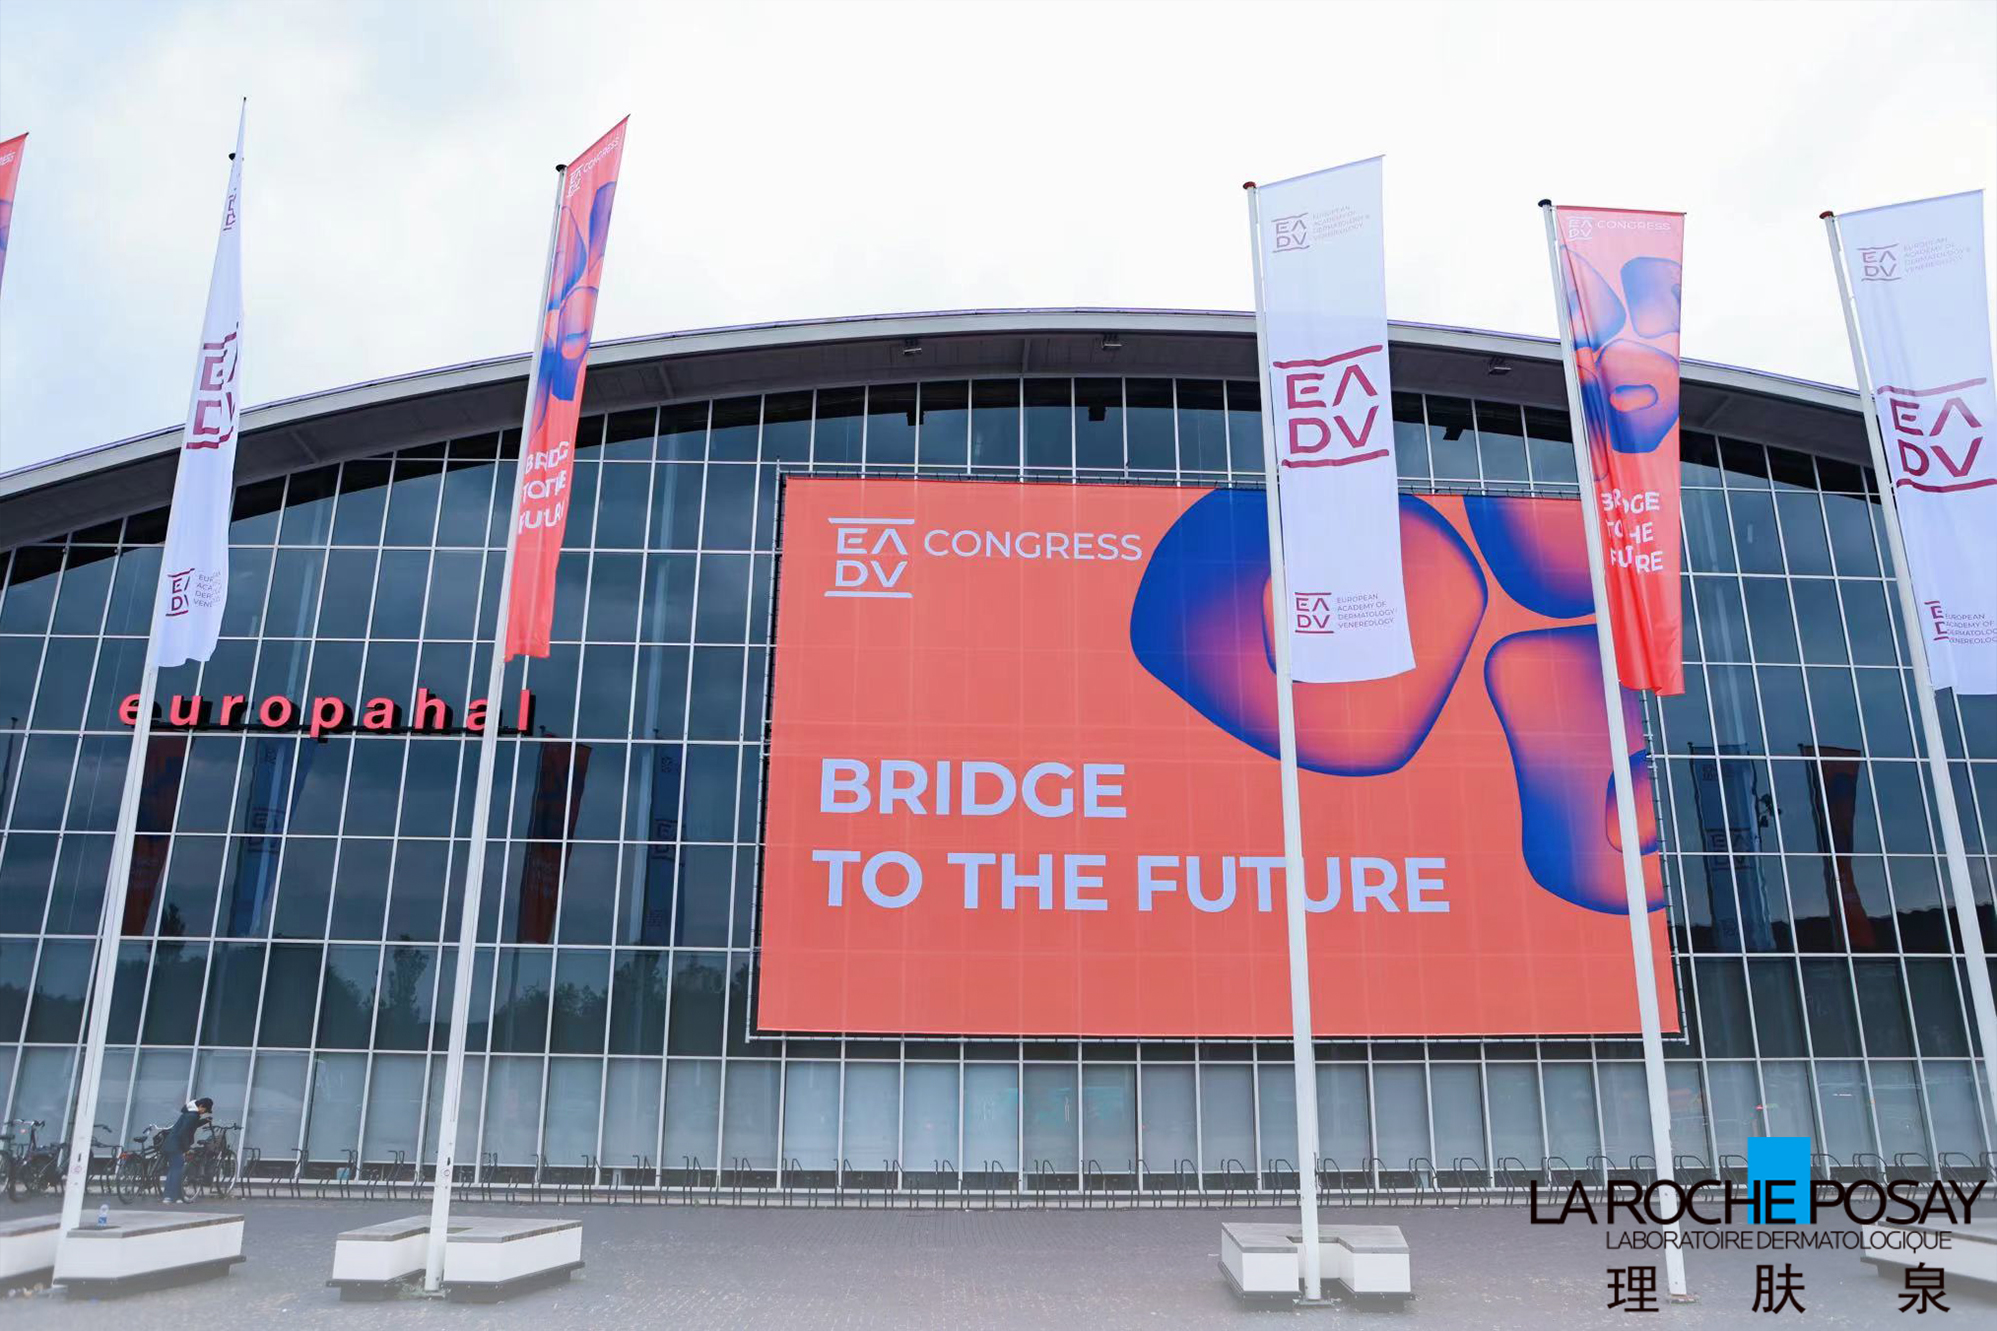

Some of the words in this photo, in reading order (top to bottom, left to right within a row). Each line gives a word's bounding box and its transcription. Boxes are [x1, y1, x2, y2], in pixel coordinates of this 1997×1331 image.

[1597, 220, 1671, 231] CONGRESS
[1288, 405, 1380, 454] DV
[1897, 436, 1984, 478] DV
[836, 527, 908, 555] EA
[923, 529, 1143, 561] CONGRESS
[835, 560, 908, 587] DV
[1337, 593, 1379, 604] EUROPEAN
[1337, 603, 1375, 612] ACADEMY
[1375, 600, 1387, 608] OF
[1297, 614, 1330, 629] DV
[1337, 607, 1395, 621] DERMATOLOGY
[1338, 617, 1395, 629] VENEREOLOGY
[118, 688, 530, 738] europahal
[819, 757, 1127, 819] BRIDGE
[811, 849, 923, 910] TO
[946, 852, 1109, 911] THE
[1137, 855, 1450, 914] FUTURE
